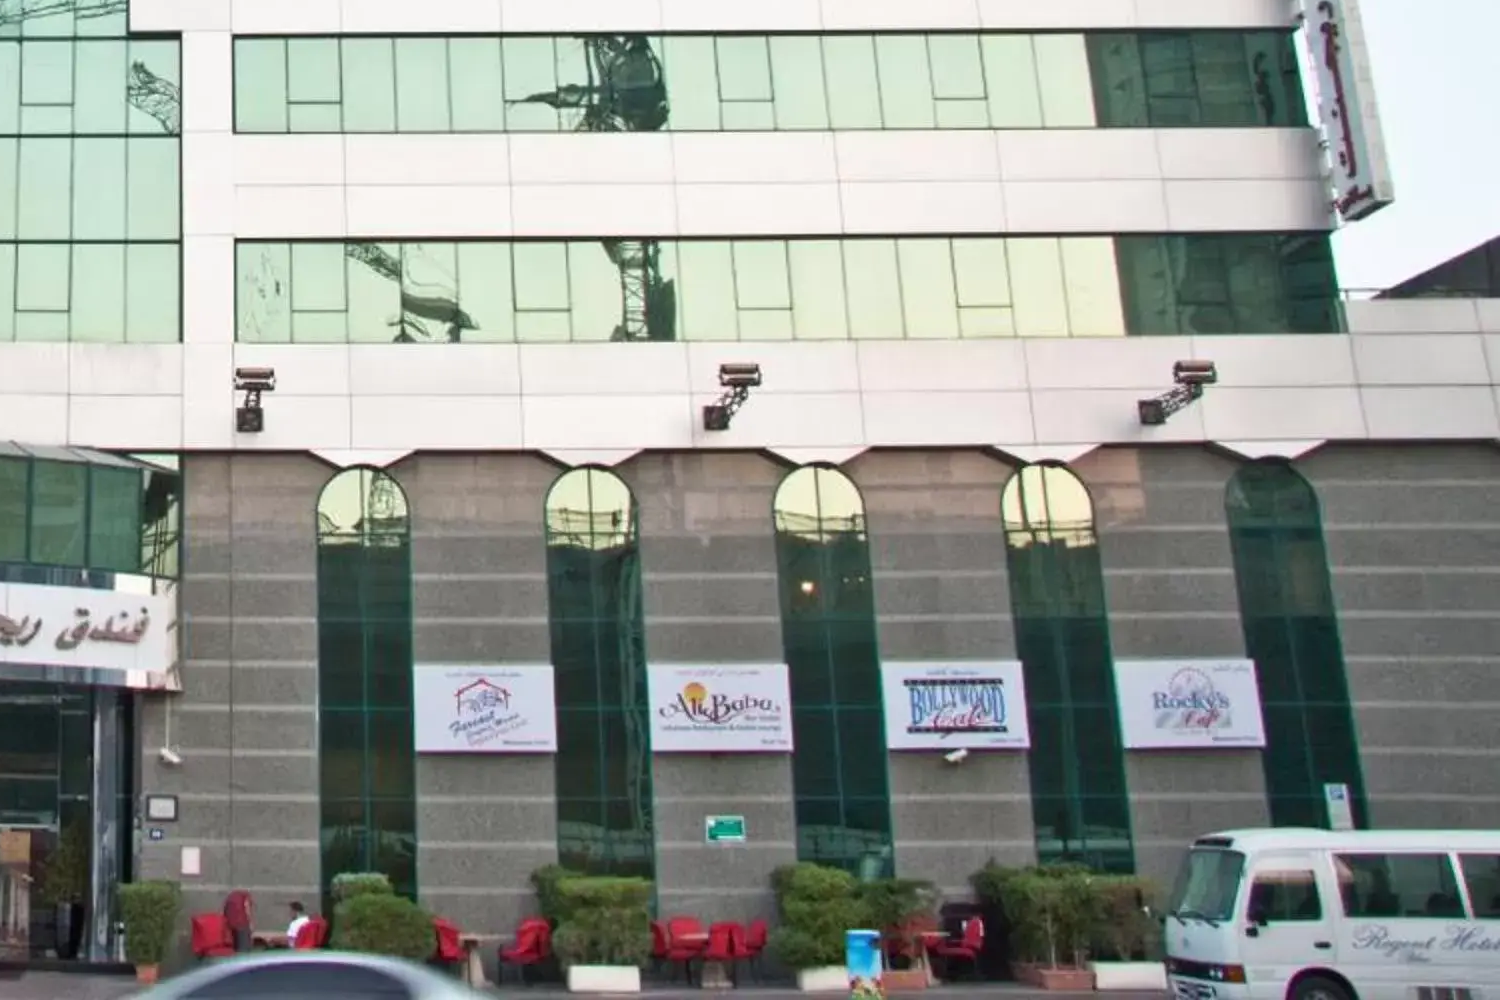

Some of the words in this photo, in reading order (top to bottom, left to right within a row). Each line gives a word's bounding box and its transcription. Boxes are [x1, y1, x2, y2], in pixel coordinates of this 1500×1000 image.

[54, 606, 150, 650] فندق
[711, 693, 773, 723] Baba
[909, 684, 1005, 726] BOLLYWOOD
[1153, 692, 1230, 711] Rocky's
[1352, 924, 1437, 957] Regent
